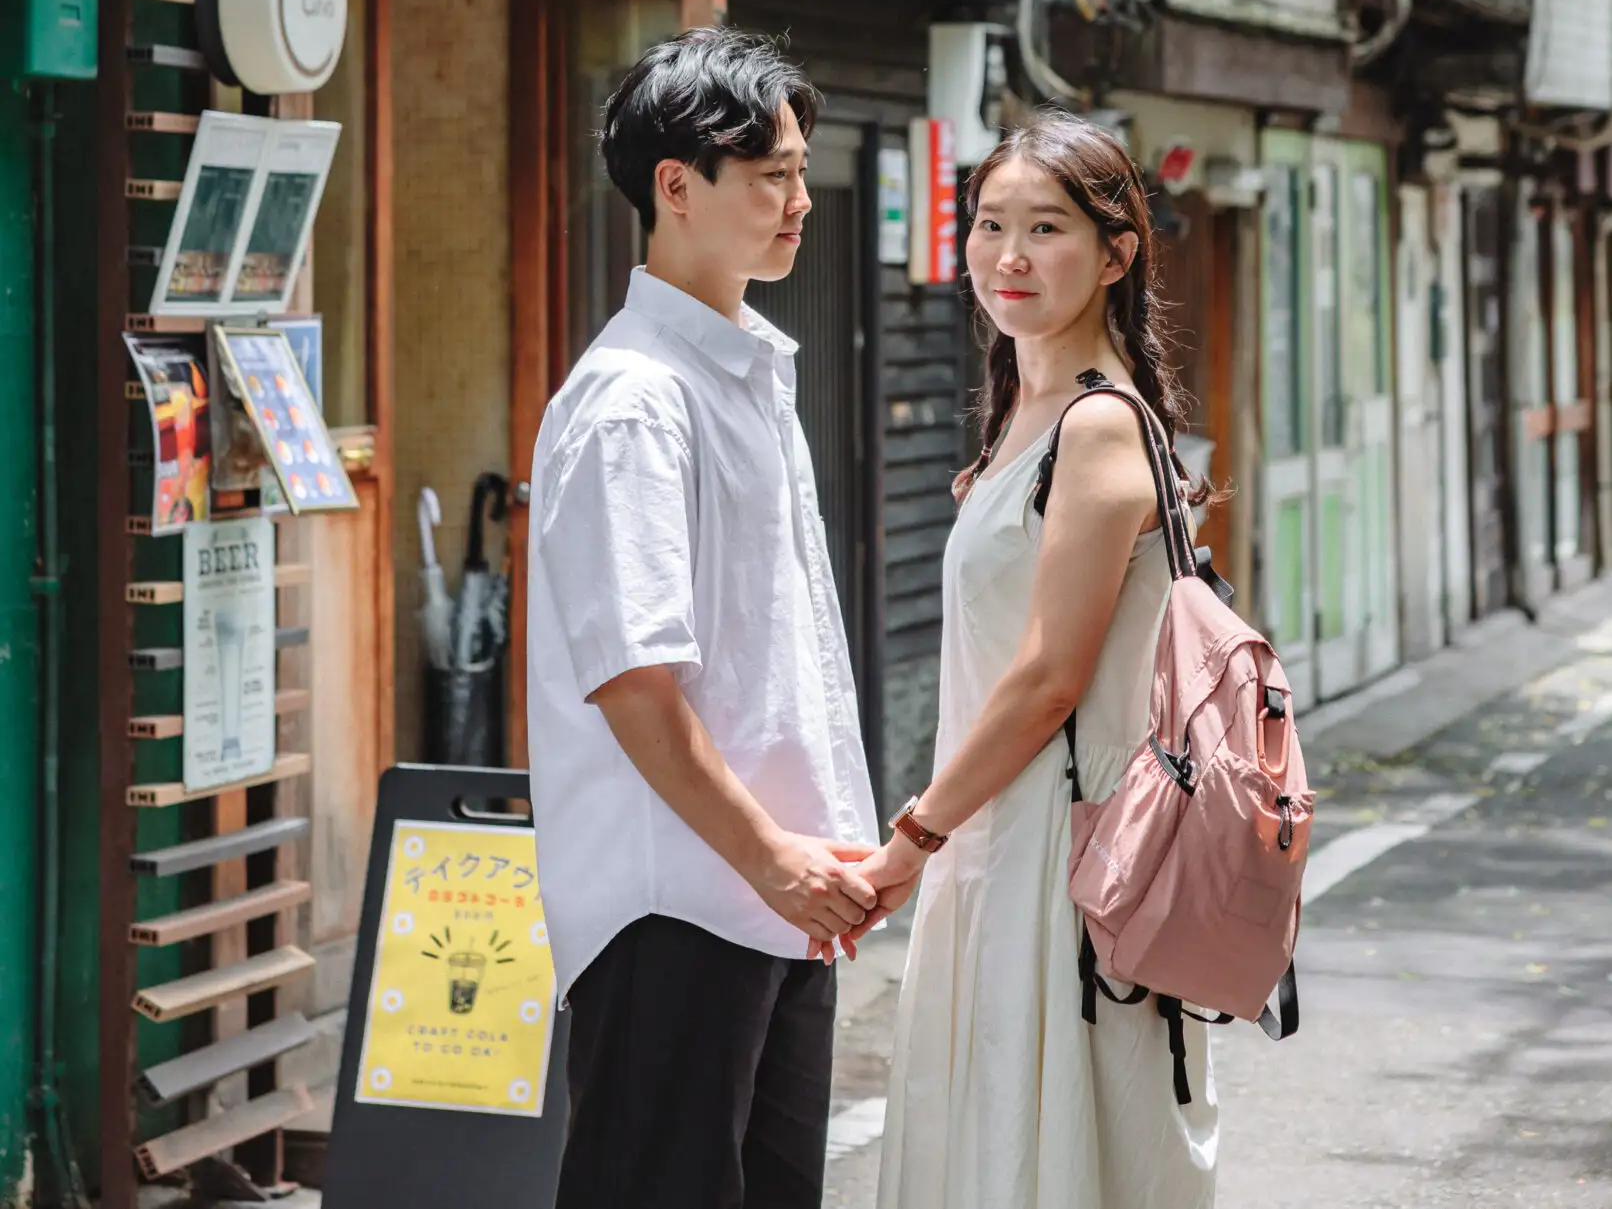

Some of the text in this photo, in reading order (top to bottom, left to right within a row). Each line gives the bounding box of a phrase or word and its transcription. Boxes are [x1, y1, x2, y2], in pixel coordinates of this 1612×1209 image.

[198, 542, 260, 577] BEER
[404, 852, 541, 901] テイクアウ
[406, 1024, 508, 1042] CRAFT COLA
[412, 1040, 433, 1053] TO
